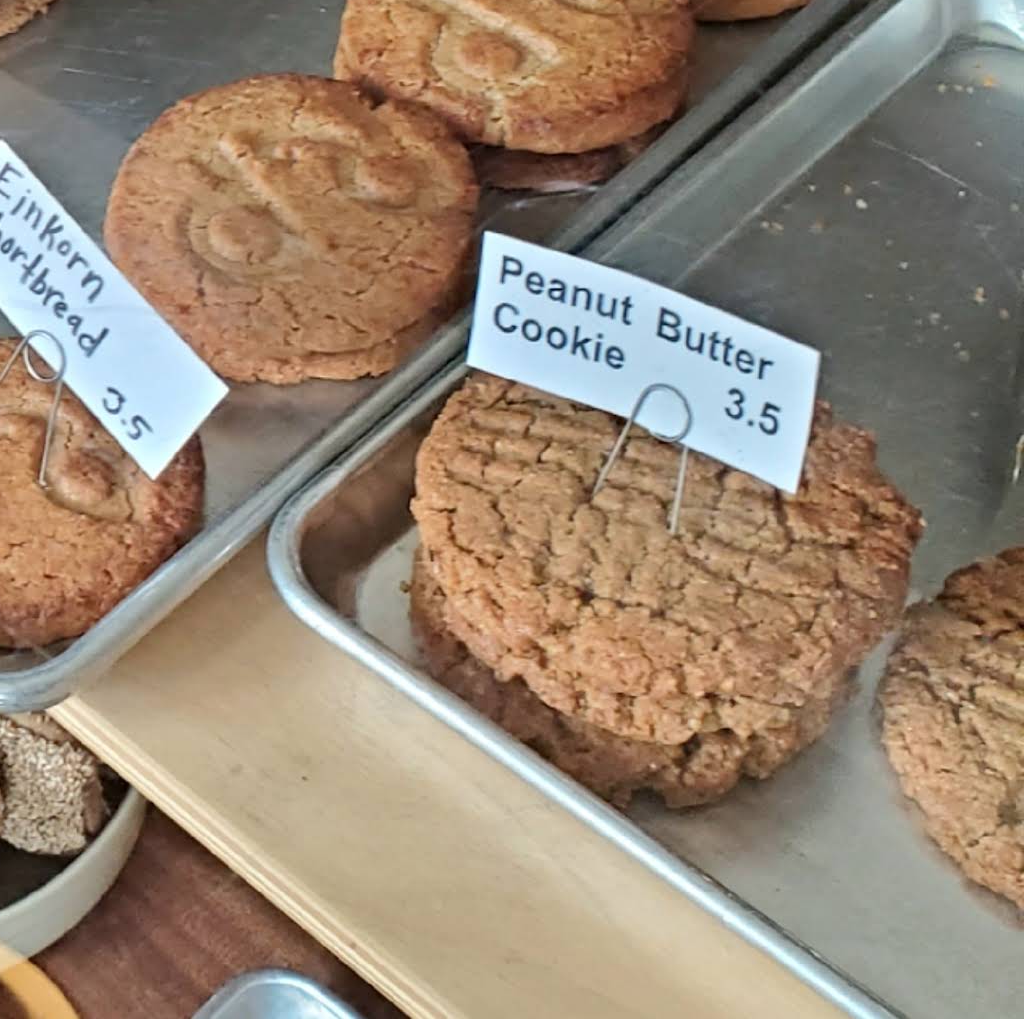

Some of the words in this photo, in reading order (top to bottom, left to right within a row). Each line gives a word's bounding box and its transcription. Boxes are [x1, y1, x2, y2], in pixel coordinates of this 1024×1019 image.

[493, 302, 627, 369] Cookie
[724, 388, 782, 436] 3.5
[499, 255, 634, 326] Peanut
[656, 306, 775, 380] Butter
[101, 387, 155, 441] 3.5
